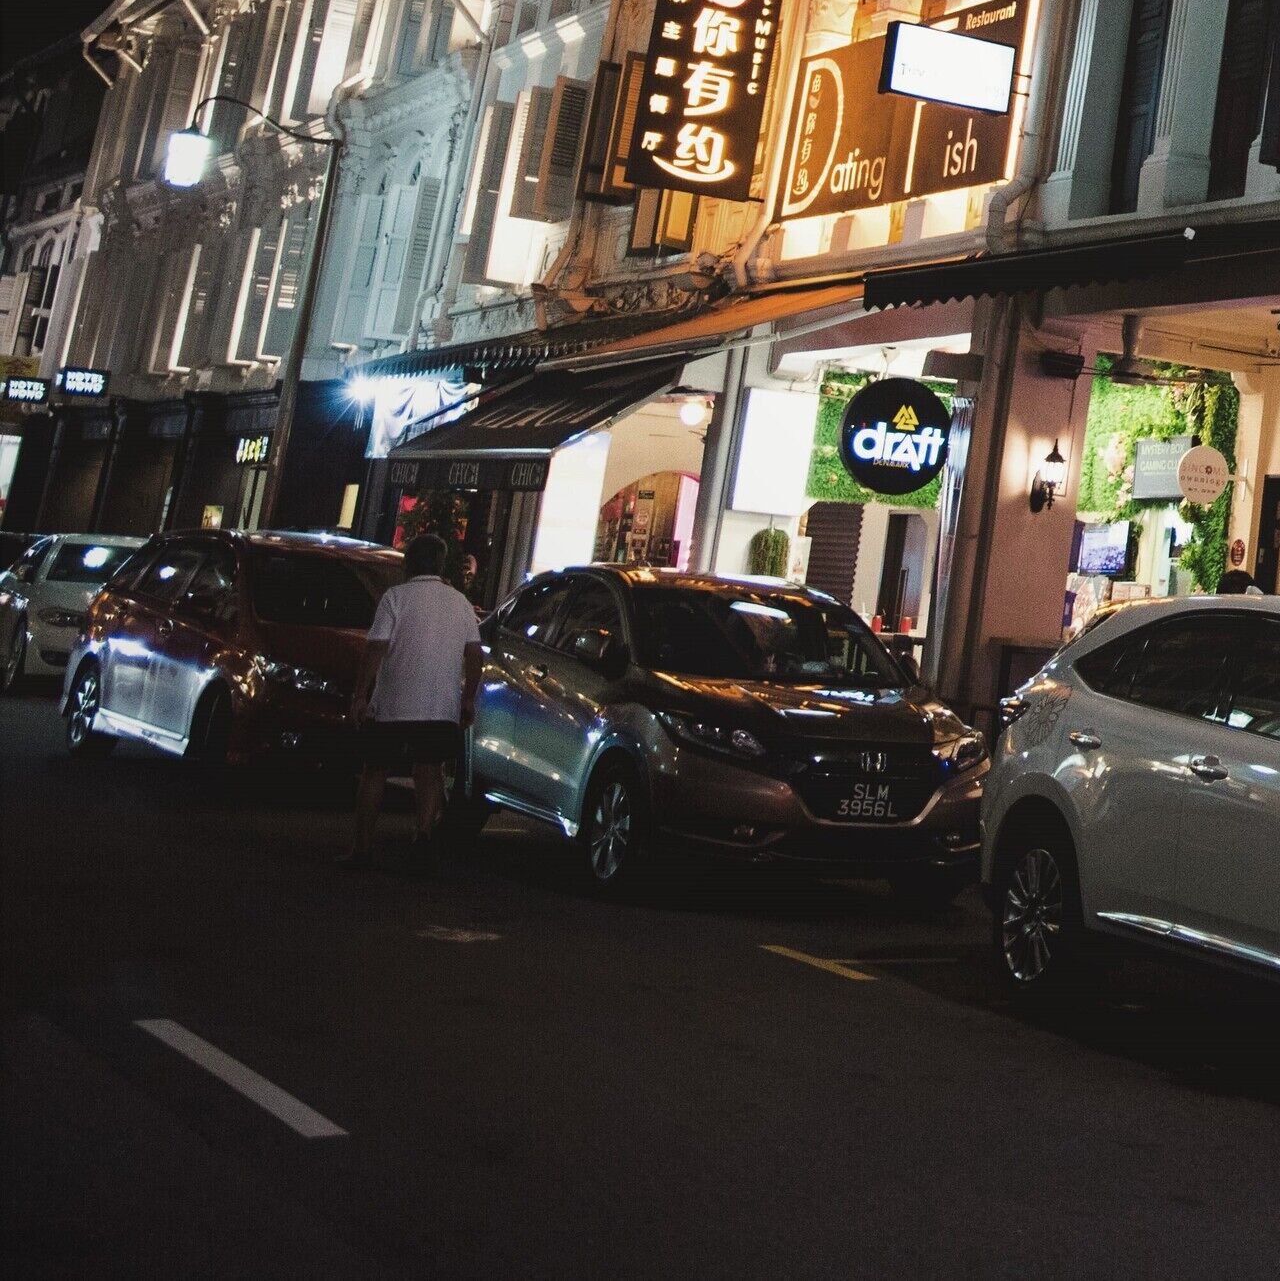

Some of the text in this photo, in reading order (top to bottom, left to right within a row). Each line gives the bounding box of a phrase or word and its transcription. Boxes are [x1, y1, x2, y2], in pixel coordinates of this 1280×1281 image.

[965, 1, 1017, 31] Restaurant
[853, 783, 890, 800] SLM
[837, 799, 898, 818] 3956L
